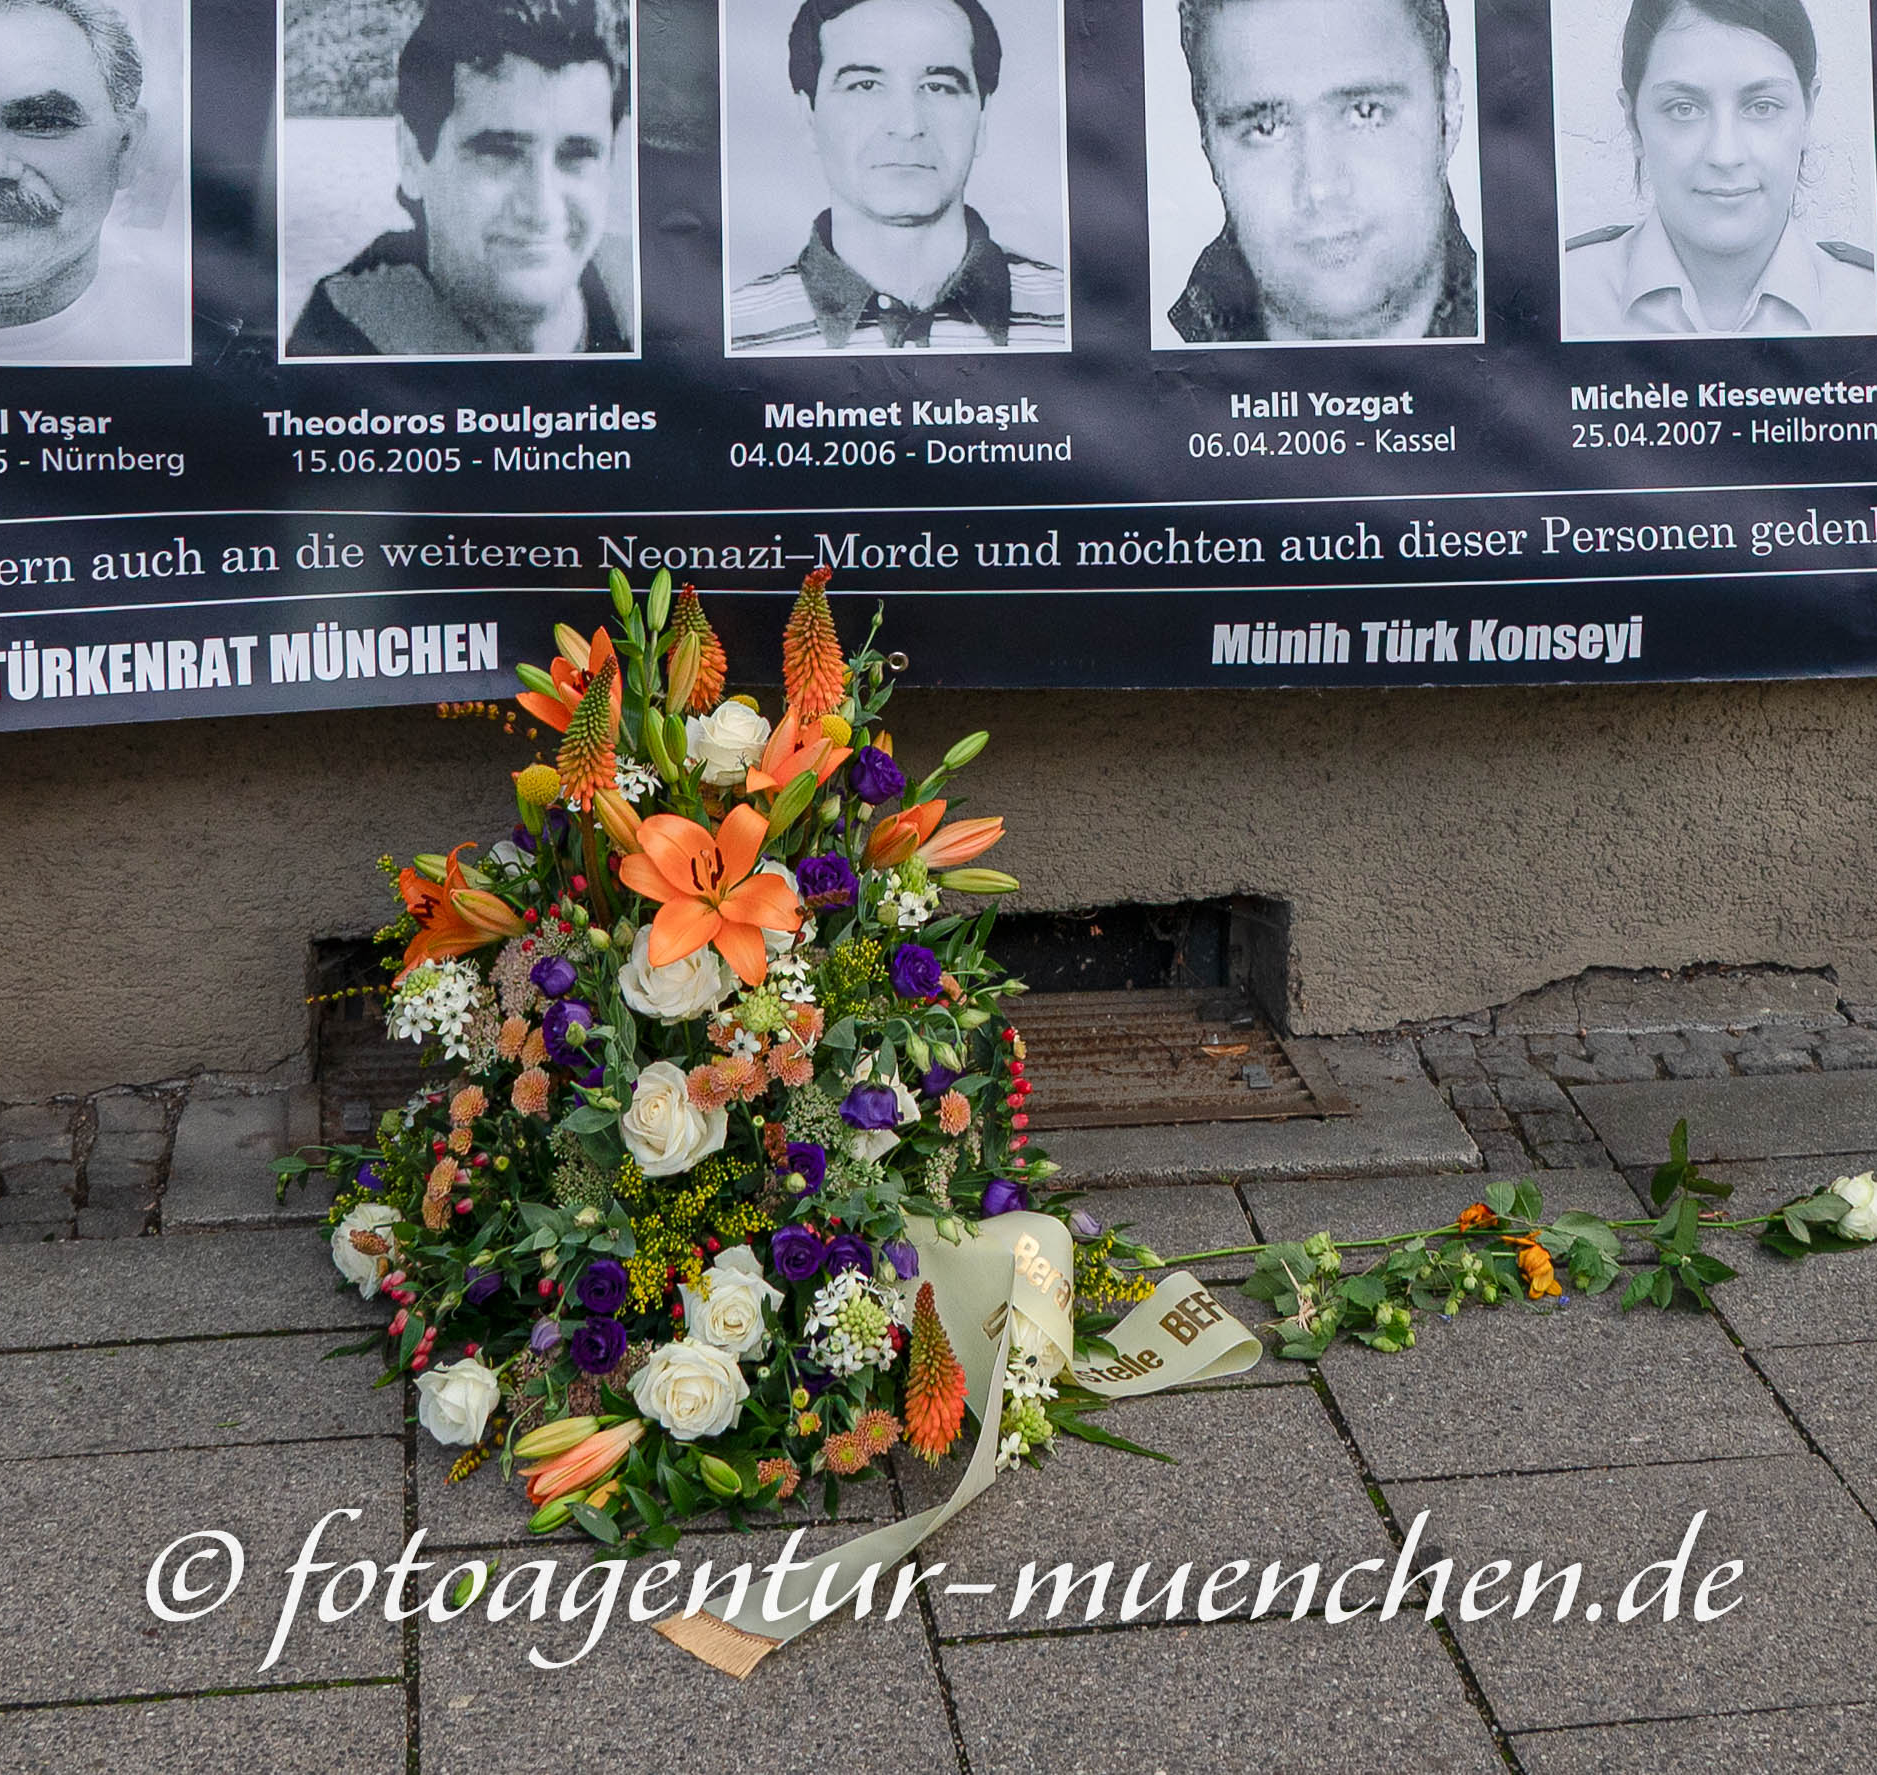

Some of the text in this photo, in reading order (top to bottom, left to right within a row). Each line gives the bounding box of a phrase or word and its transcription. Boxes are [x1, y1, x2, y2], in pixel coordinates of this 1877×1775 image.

[1231, 392, 1413, 421] Halil Yozgat
[1571, 382, 1877, 410] Michèle Kiesewetter
[19, 411, 111, 440] Yaşar
[263, 404, 656, 438] Theodoros Boulgarides
[766, 397, 1039, 430] Mehmet Kubaşık
[1189, 426, 1455, 457] 06.04.2006 Kassel
[1573, 417, 1877, 447] 25.04.2007 Heilbronn
[43, 447, 183, 476] Nürnberg
[293, 444, 630, 472] 15.06.2005 München
[731, 435, 1071, 467] 04.04.2006 Dortmund
[91, 538, 205, 581] auch
[221, 545, 280, 573] an
[296, 533, 364, 569] die
[380, 536, 583, 568] weiteren
[975, 530, 1060, 567] und
[1076, 528, 1266, 566] möchten
[1280, 522, 1384, 561] auch
[1399, 520, 1527, 558] dieser
[1541, 516, 1737, 555] Personen
[270, 623, 497, 683] MÜNCHEN
[1212, 616, 1642, 664] Münih Türk Konseyi
[1074, 1291, 1227, 1383] stelle BEF
